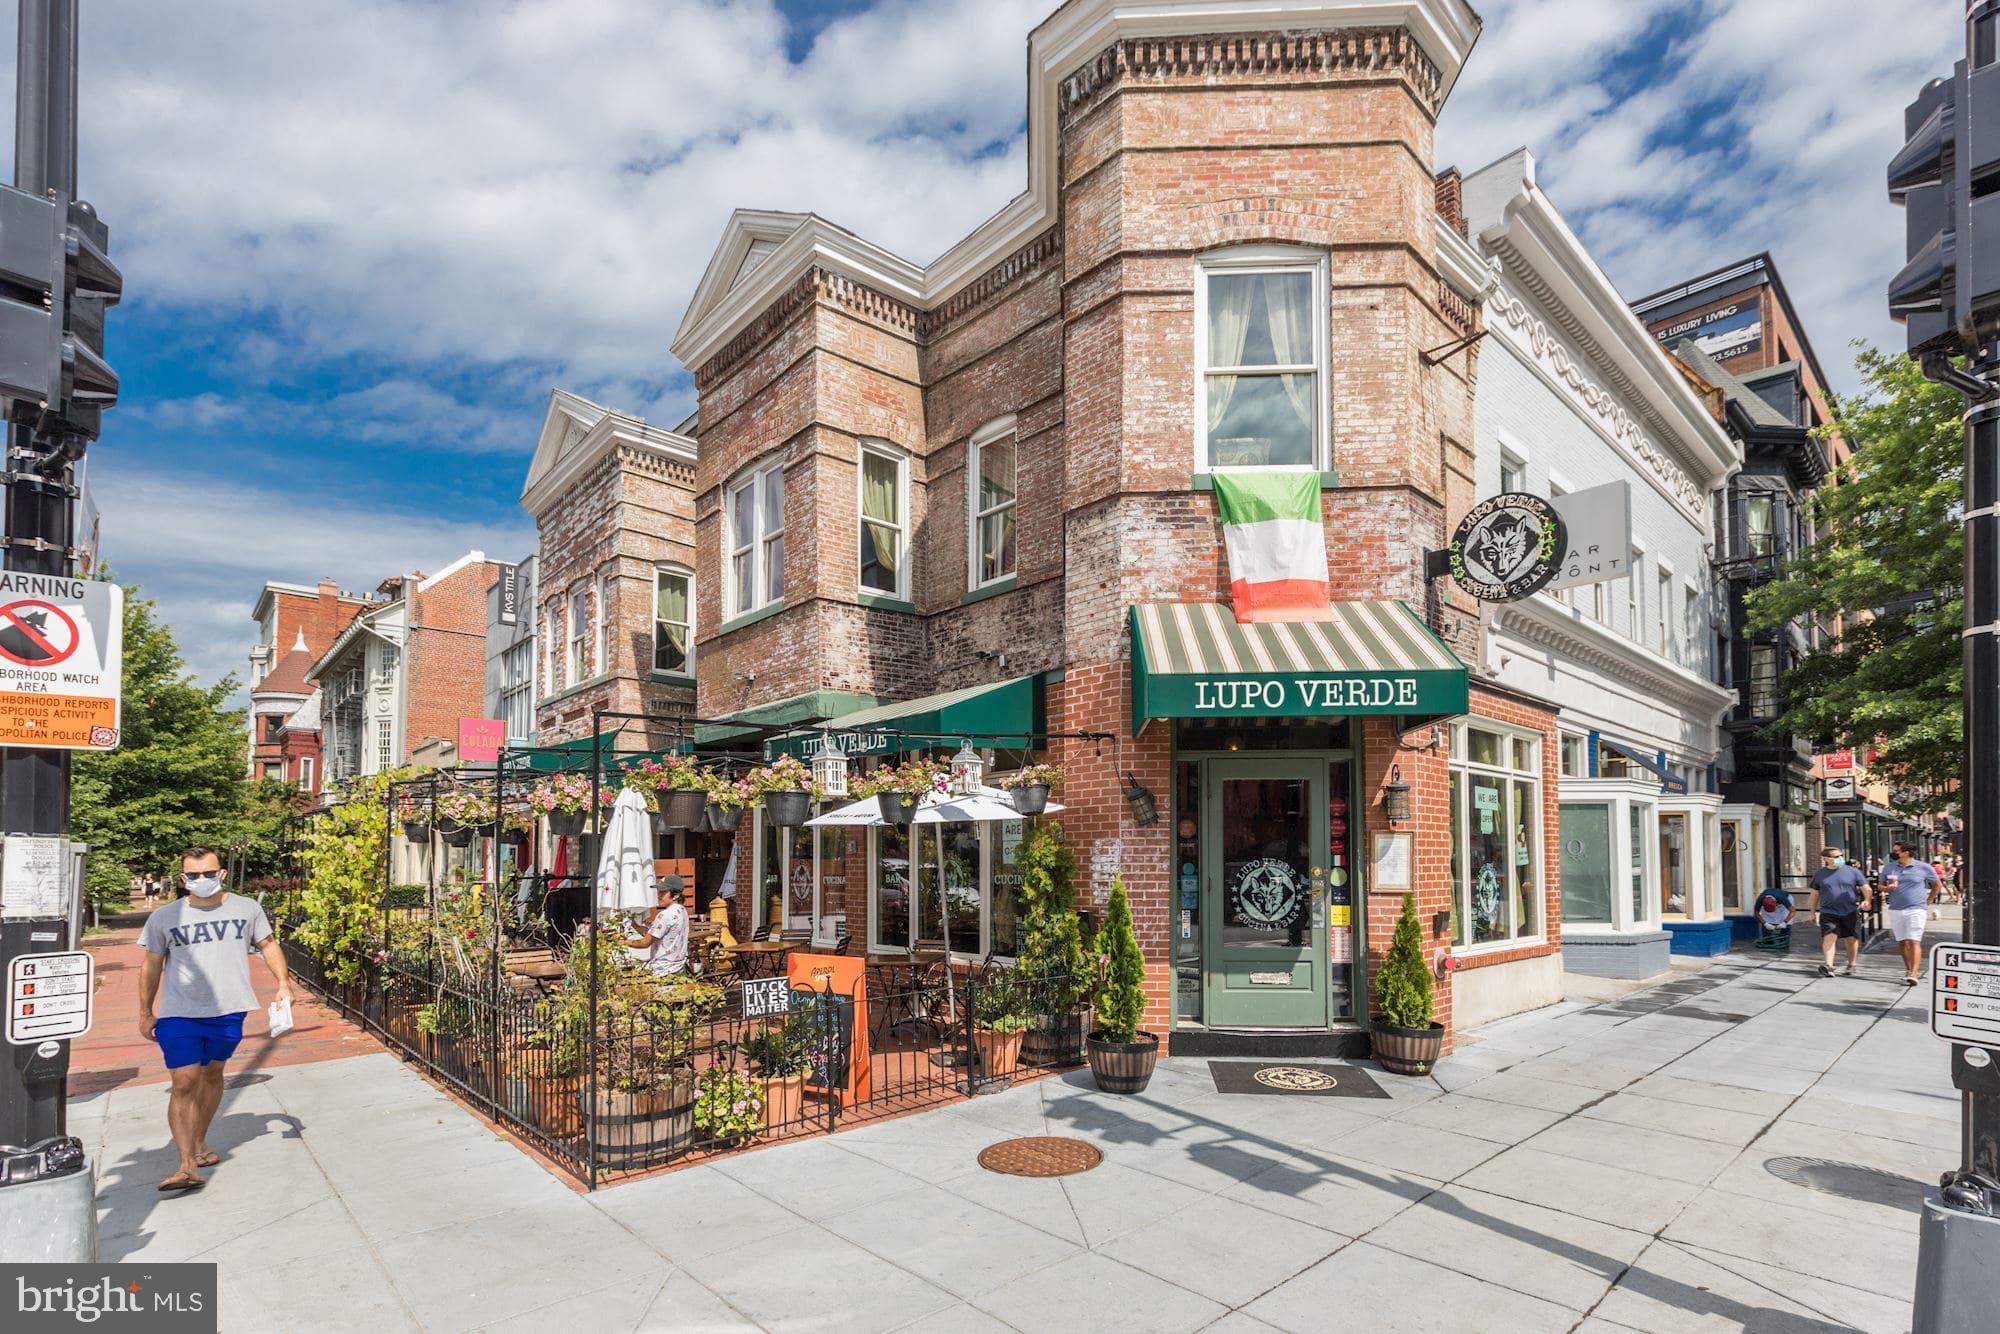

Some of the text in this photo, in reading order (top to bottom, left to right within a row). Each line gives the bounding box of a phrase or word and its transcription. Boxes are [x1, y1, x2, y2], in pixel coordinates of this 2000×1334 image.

[1668, 318, 1703, 337] LUXURY
[1705, 305, 1738, 324] LIVING
[1522, 563, 1549, 589] BAR
[63, 672, 99, 685] WATCH
[16, 682, 48, 692] AREA
[1195, 678, 1418, 709] LUPO VERDE
[64, 699, 110, 710] REPORTS
[53, 709, 96, 720] ACTIVITY
[12, 717, 25, 727] TO
[52, 730, 88, 741] POLICE
[1005, 824, 1021, 835] ARE
[1236, 859, 1260, 881] LUPO
[885, 874, 902, 883] BAR
[994, 874, 1024, 885] CUCIN
[169, 919, 248, 947] NAVY
[744, 980, 788, 996] BLACK
[745, 990, 788, 1008] LIVES
[1967, 1001, 1984, 1009] DON'T
[746, 1003, 789, 1017] MATTER
